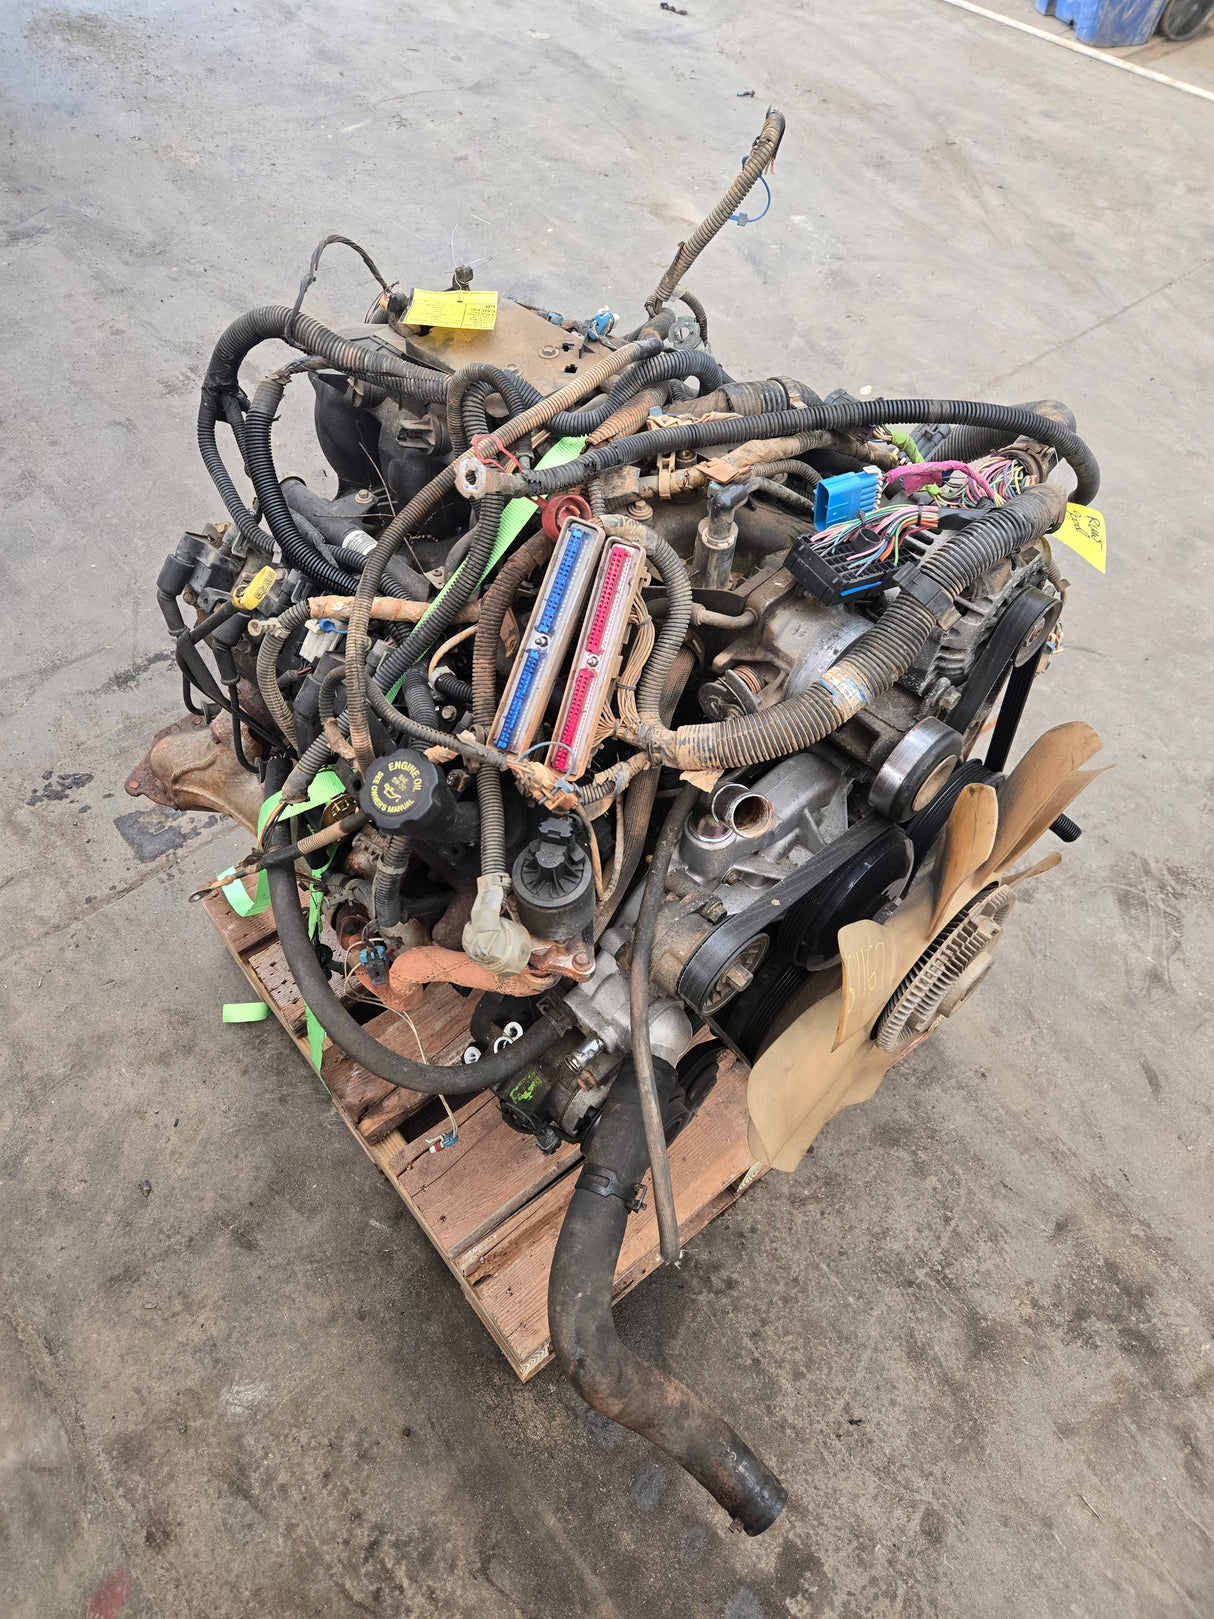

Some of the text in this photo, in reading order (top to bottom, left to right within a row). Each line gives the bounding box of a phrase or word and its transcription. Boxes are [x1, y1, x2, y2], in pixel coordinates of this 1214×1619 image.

[372, 771, 384, 784] SEE
[387, 799, 415, 812] MANUAL
[388, 761, 422, 792] ENGINE OIL
